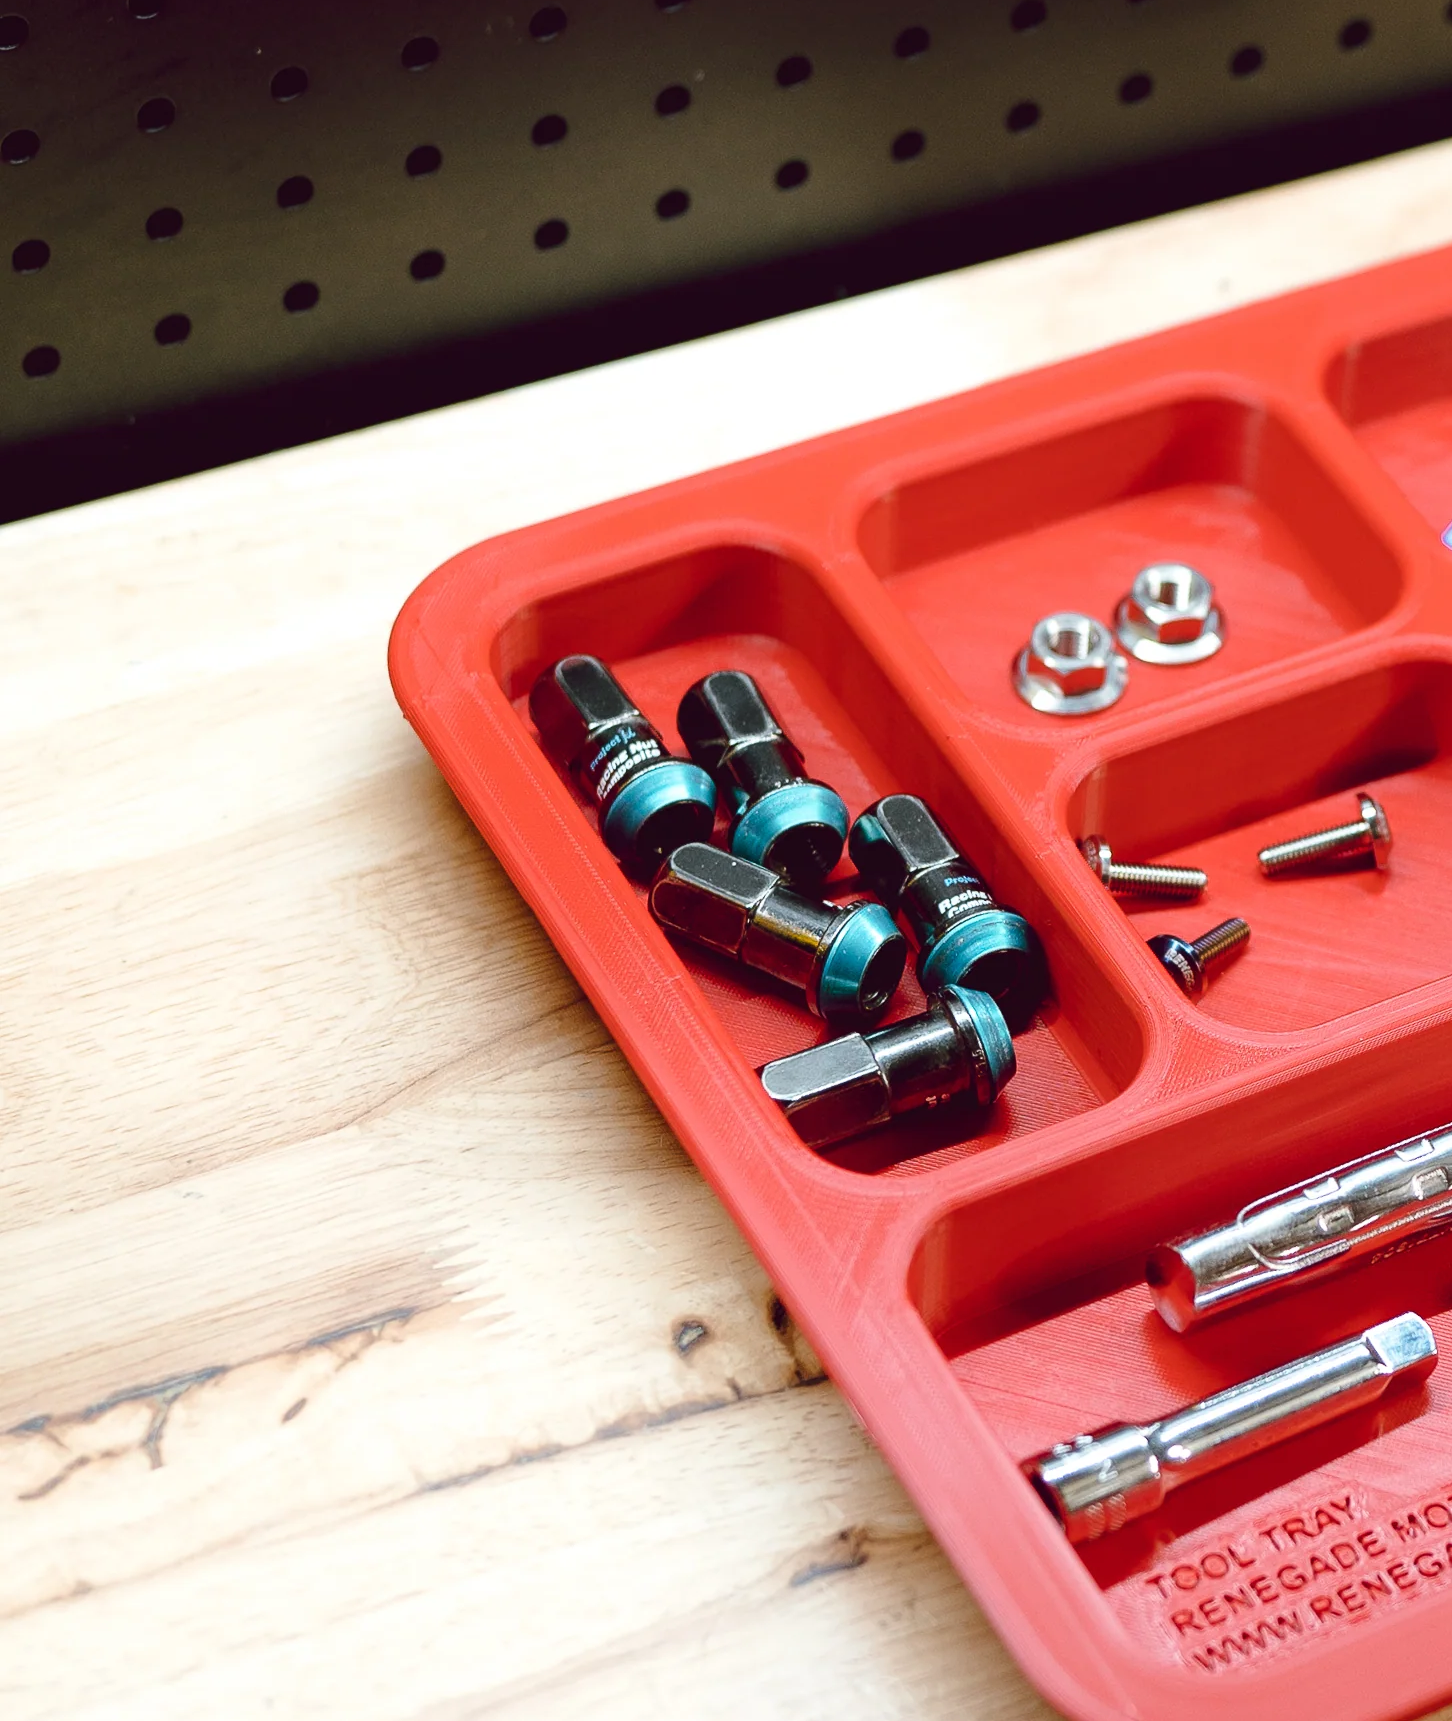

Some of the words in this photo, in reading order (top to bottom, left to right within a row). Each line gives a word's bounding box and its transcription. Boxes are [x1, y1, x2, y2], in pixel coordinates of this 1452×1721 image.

[1146, 1545, 1256, 1599] TOOL
[1259, 1495, 1355, 1552] TRAY
[1170, 1529, 1388, 1636] RENEGADE
